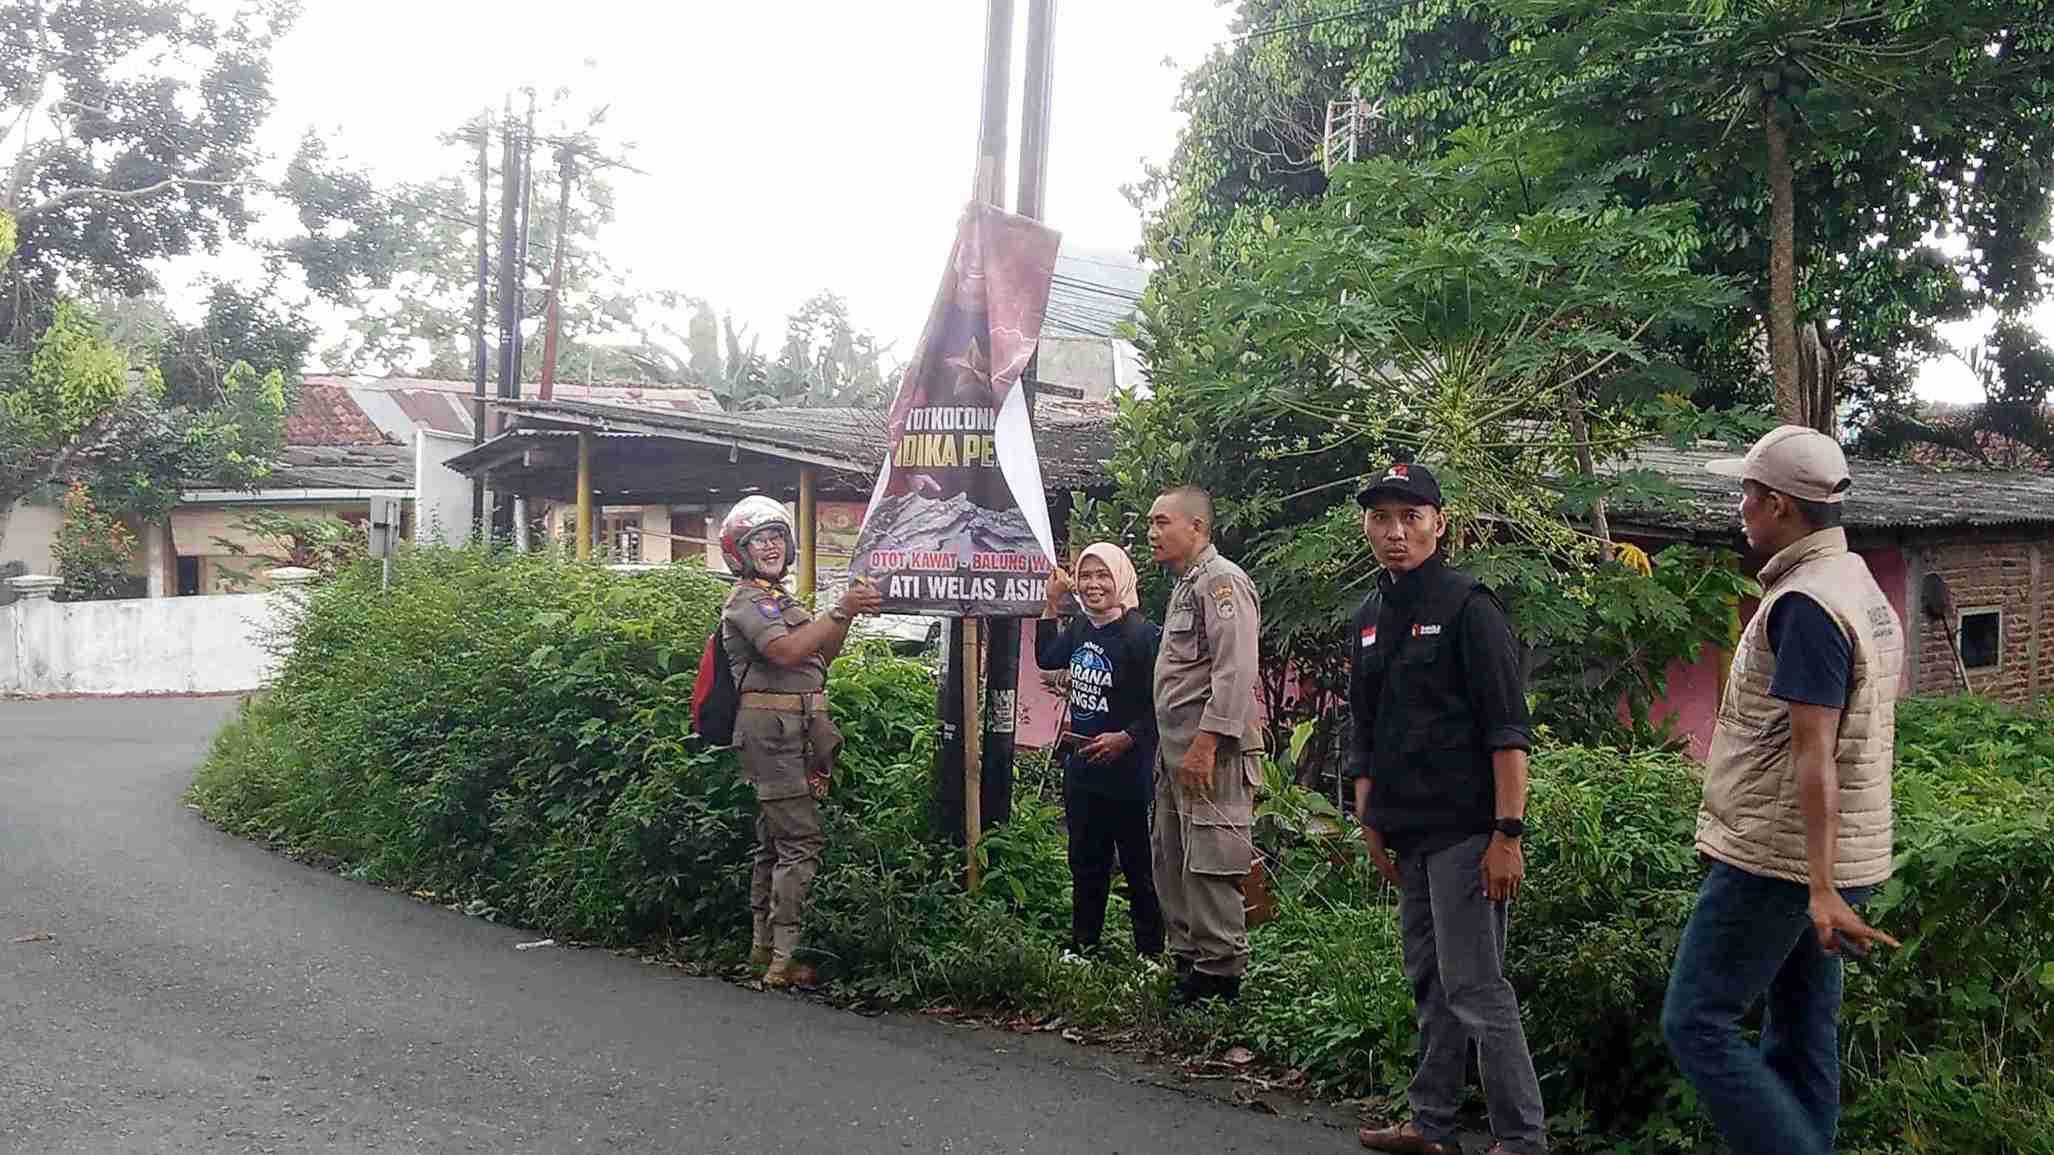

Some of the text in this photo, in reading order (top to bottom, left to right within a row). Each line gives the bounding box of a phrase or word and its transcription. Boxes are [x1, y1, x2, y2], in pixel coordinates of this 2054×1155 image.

[872, 551, 904, 567] OTOT
[911, 551, 957, 569] KAWAT
[972, 552, 1026, 571] BALUNG
[889, 575, 1048, 601] ATI WELAS ASIH
